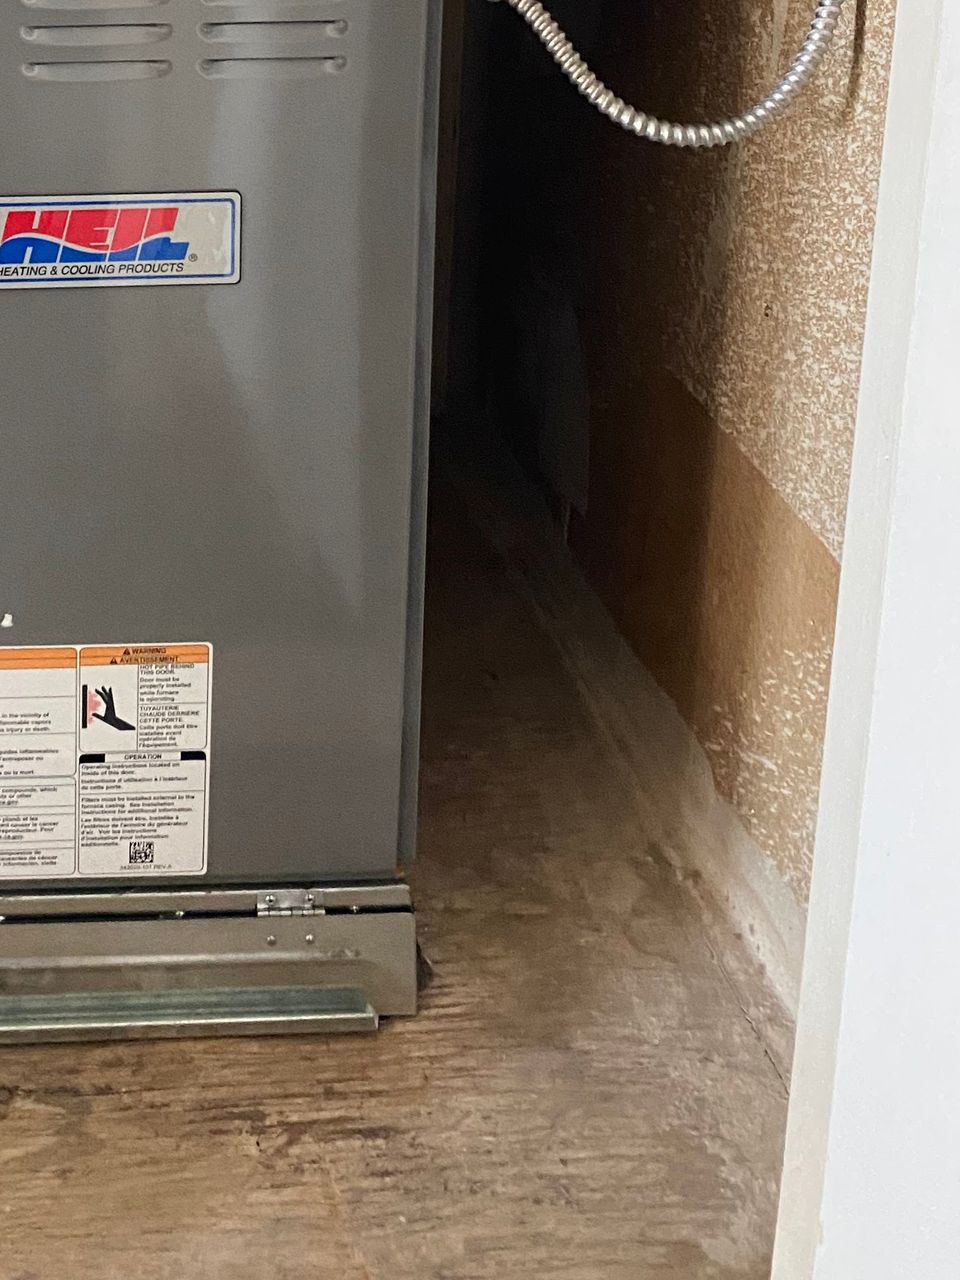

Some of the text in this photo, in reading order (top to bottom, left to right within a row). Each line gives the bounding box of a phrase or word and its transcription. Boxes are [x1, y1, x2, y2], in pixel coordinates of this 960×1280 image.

[50, 265, 57, 275] &
[61, 264, 115, 275] COOLING
[118, 262, 184, 274] PRODUCTS
